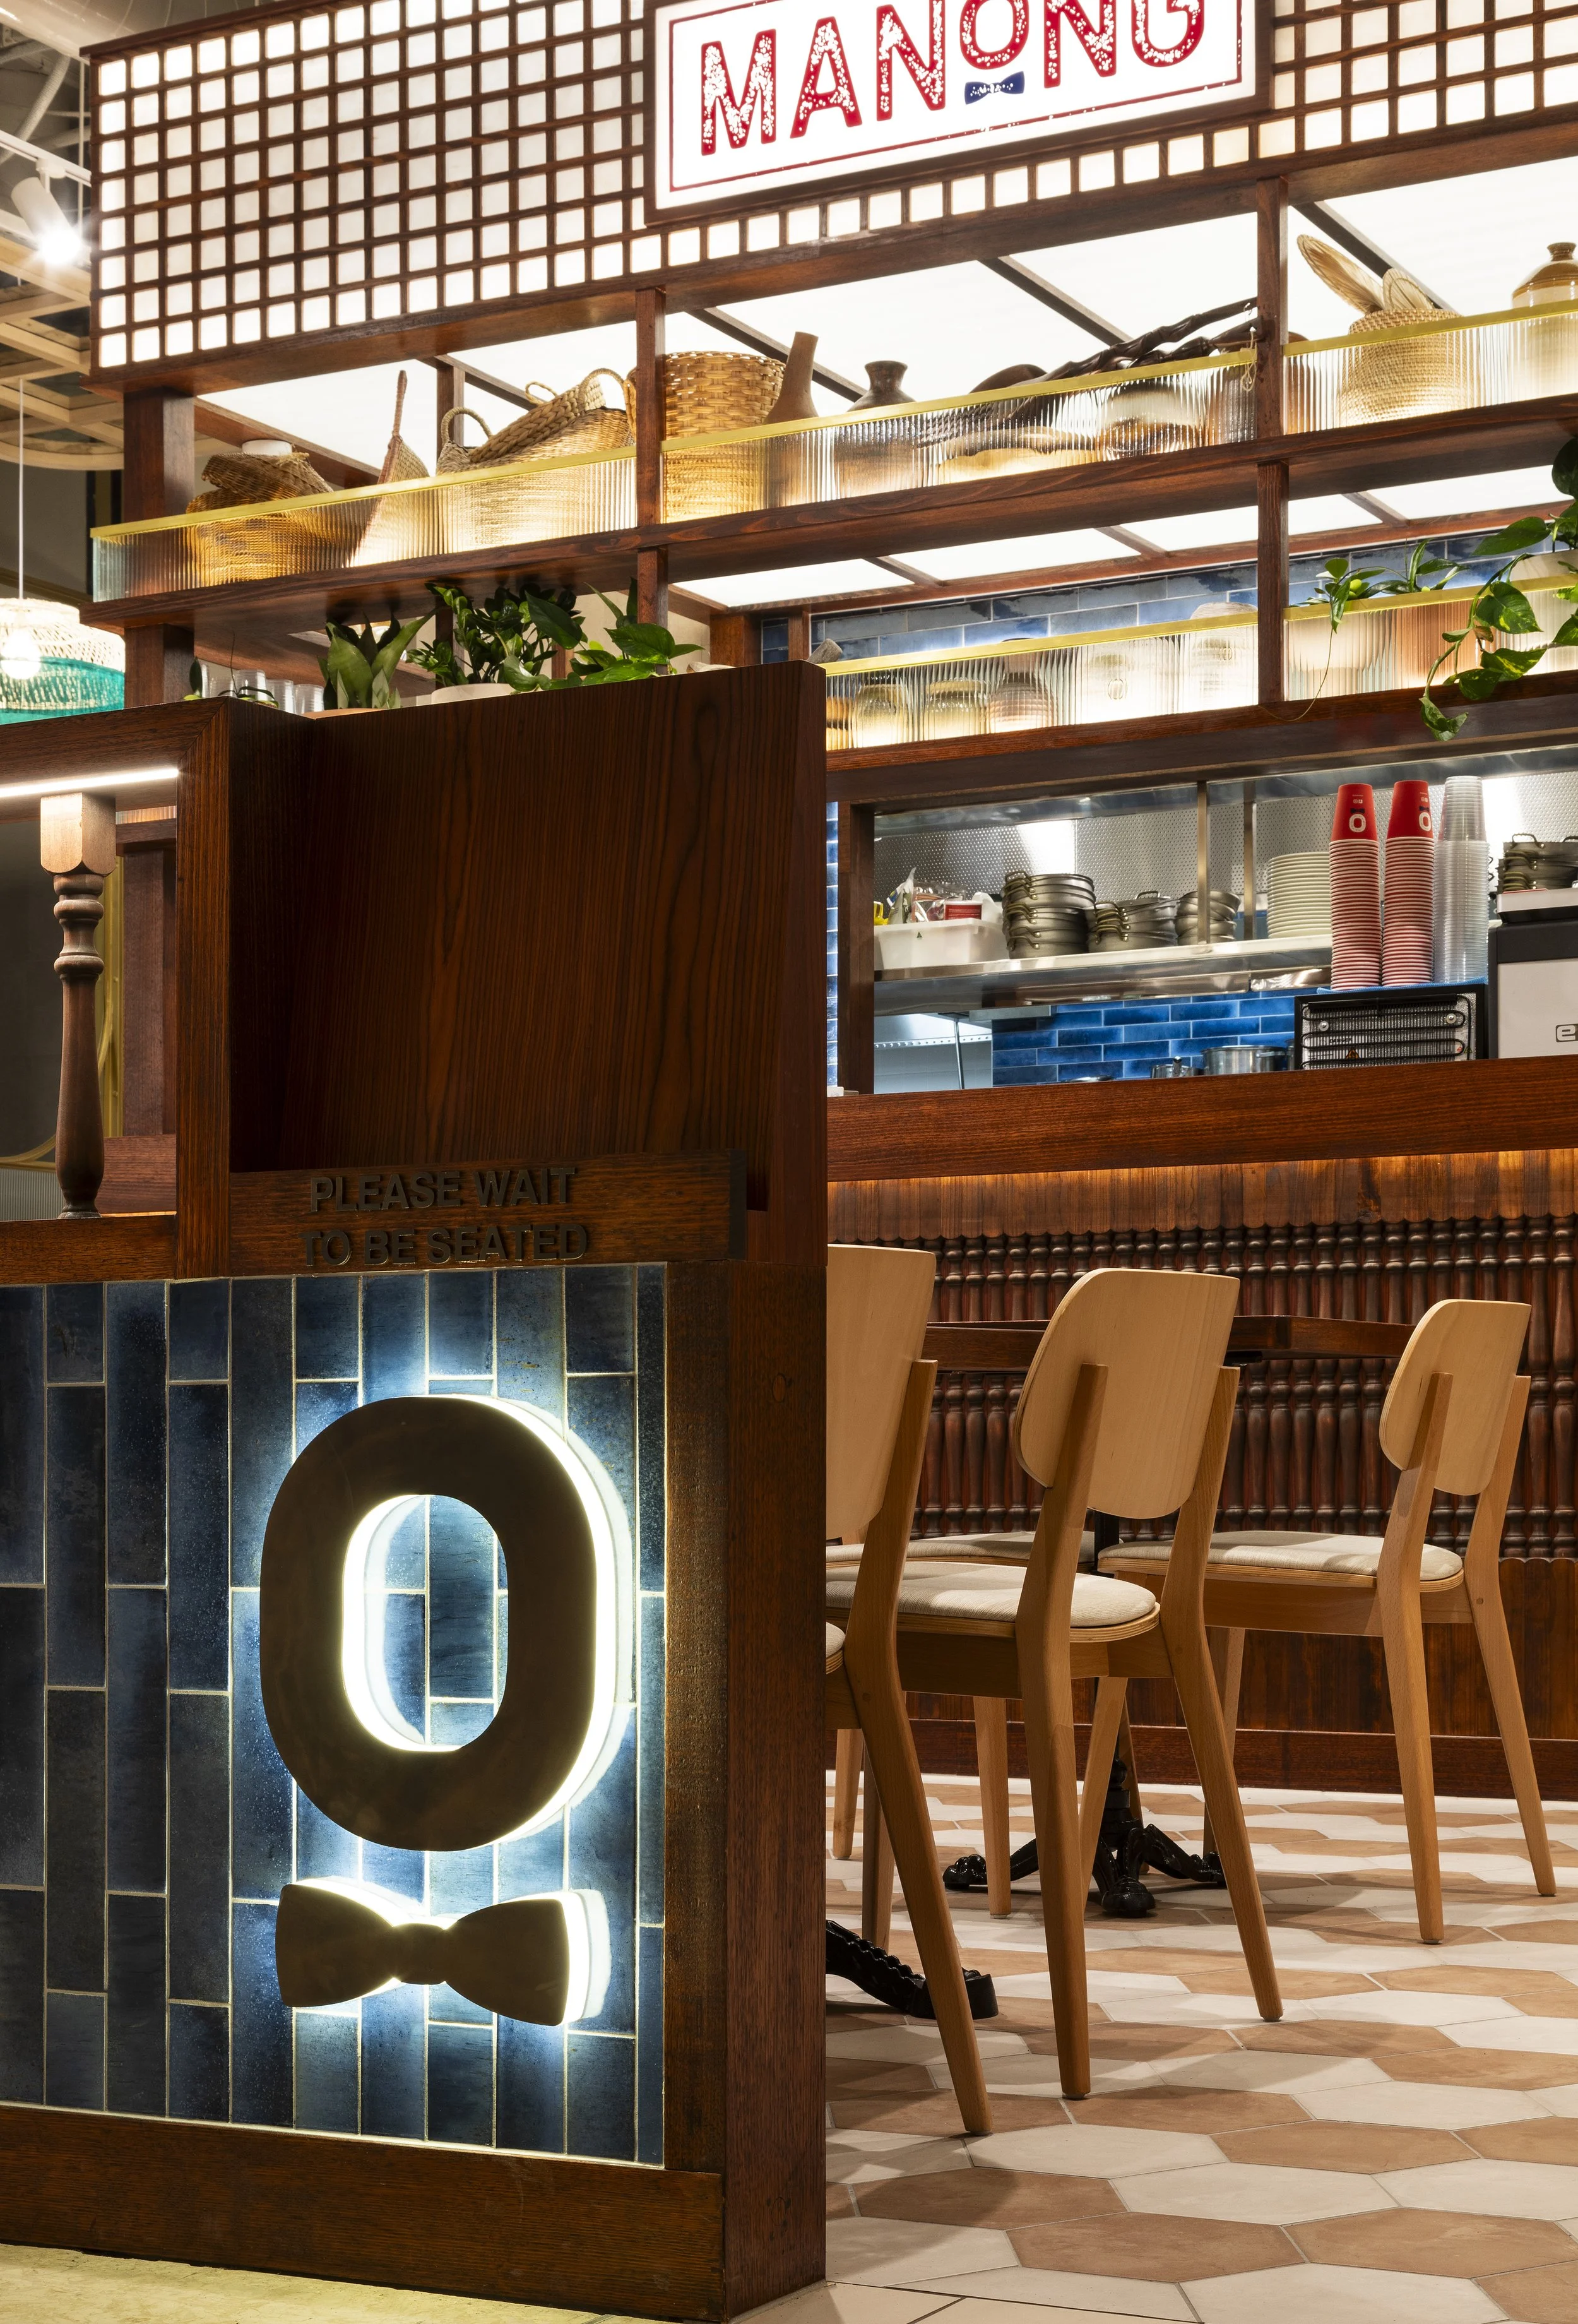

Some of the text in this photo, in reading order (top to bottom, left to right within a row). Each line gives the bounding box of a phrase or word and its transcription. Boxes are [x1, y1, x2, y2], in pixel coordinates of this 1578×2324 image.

[701, 0, 1205, 155] MANONG
[310, 1167, 576, 1212] PLEASE WAIT
[299, 1224, 588, 1266] TO BE SEATED
